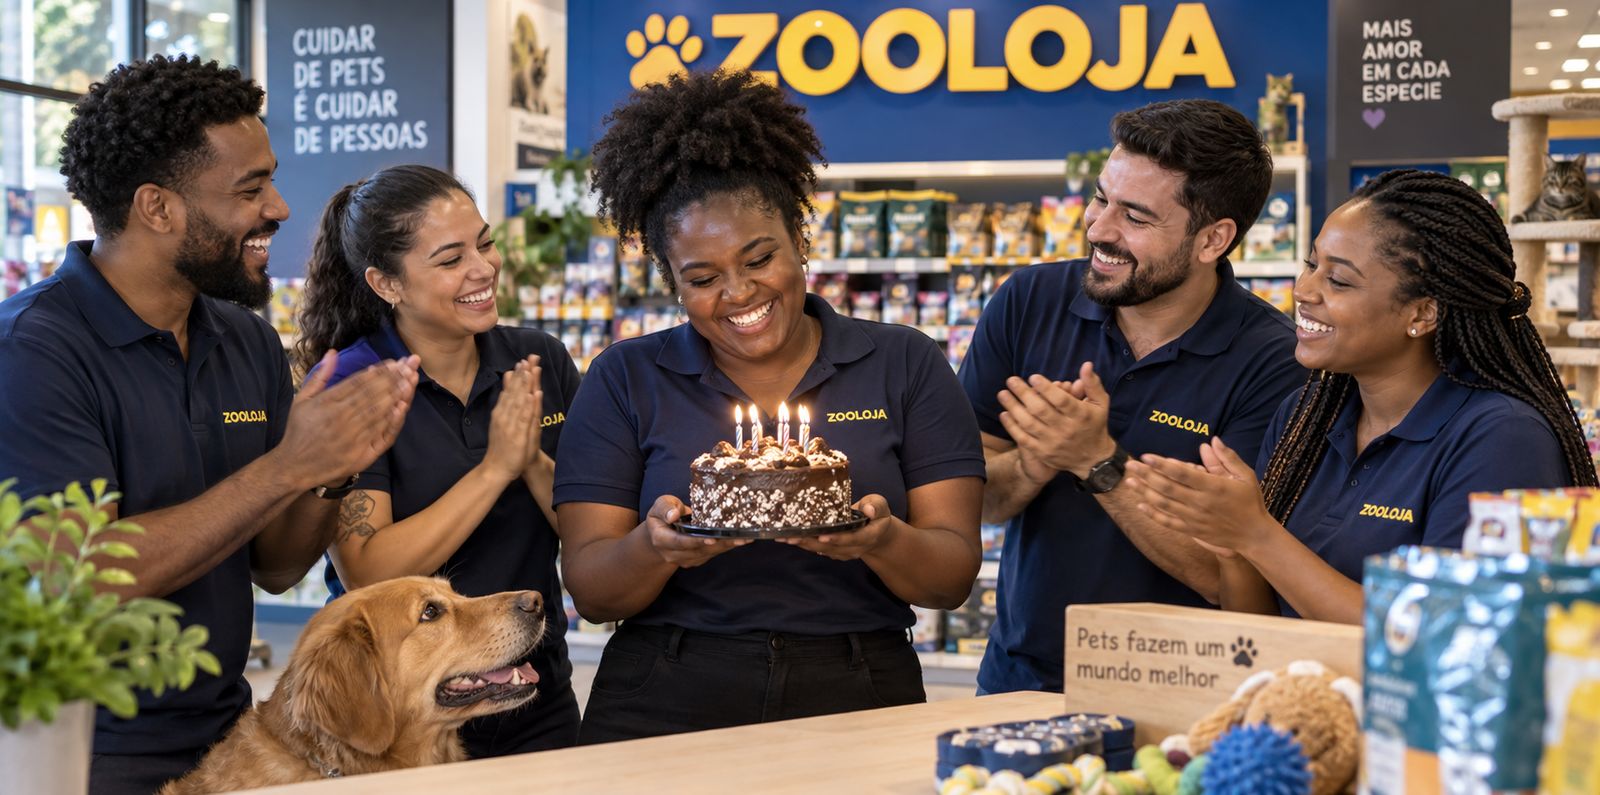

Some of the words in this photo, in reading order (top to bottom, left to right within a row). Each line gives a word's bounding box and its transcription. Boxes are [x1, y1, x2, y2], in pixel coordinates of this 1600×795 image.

[292, 24, 377, 56] CUIDAR
[1363, 18, 1413, 40] MAIS
[711, 2, 1237, 97] ZOOLOJA
[1362, 40, 1423, 61] AMOR
[293, 60, 322, 89] DE
[330, 56, 385, 87] PETS
[1362, 62, 1391, 82] EM
[1396, 59, 1451, 80] CADA
[294, 88, 308, 122] É
[315, 89, 399, 121] CUIDAR
[1362, 81, 1442, 103] ESPECIE
[294, 125, 323, 155] DE
[330, 120, 428, 153] PESSOAS
[222, 410, 268, 425] ZOOLOJA
[826, 409, 889, 423] ZOOLOJA
[1149, 409, 1210, 436] ZOOLOJA
[1359, 503, 1415, 524] ZOOLOJA
[1077, 627, 1119, 651] Pets
[1127, 630, 1188, 656] fazem
[1195, 642, 1225, 657] um
[1077, 661, 1142, 682] mundo
[1149, 665, 1220, 688] melhor
